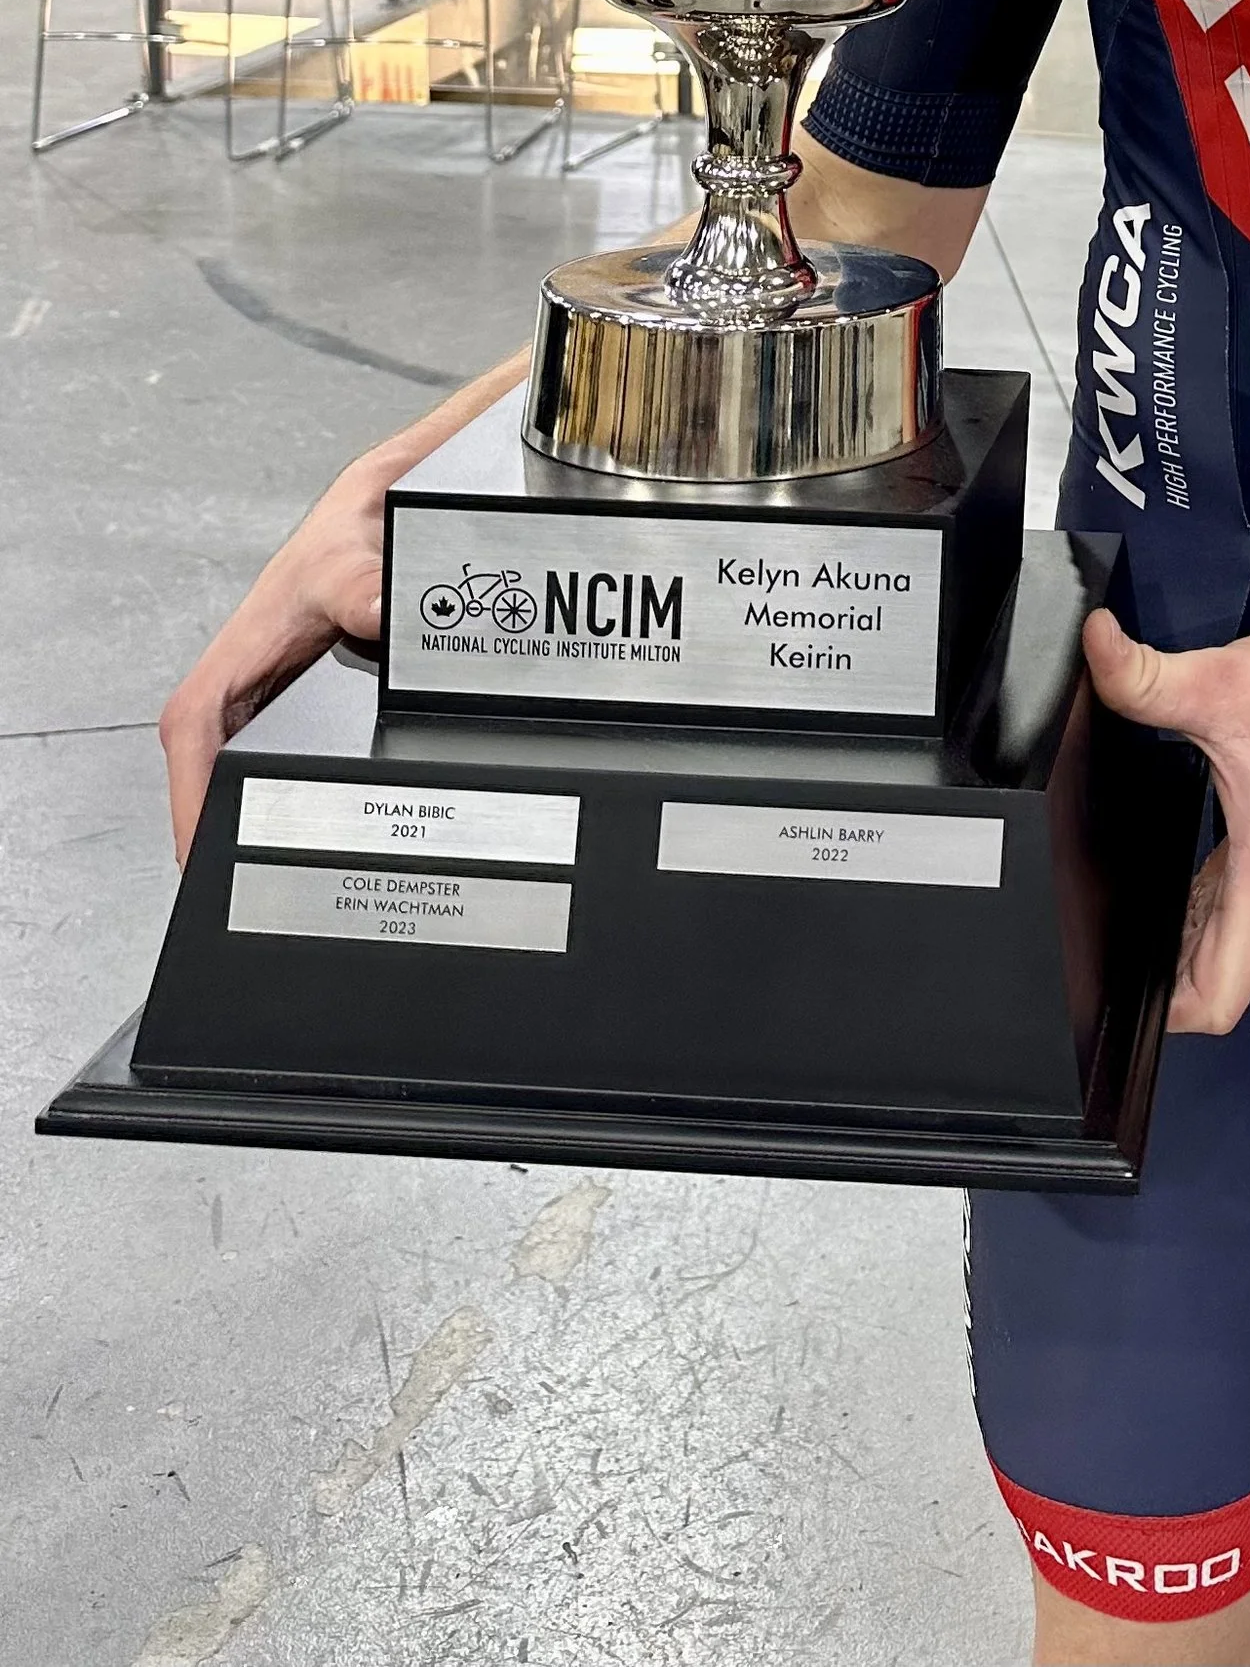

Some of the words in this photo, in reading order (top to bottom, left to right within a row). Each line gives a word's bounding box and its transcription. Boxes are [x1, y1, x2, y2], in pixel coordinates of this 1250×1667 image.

[1156, 223, 1183, 303] CYCLING
[1093, 203, 1152, 510] KWCA
[1151, 309, 1182, 460] PERFORMANCE
[1166, 458, 1191, 510] HIGH
[717, 557, 800, 593] Kelyn
[811, 562, 912, 593] Akuna
[543, 569, 684, 641] NCIM
[744, 602, 883, 632] Memorial
[421, 634, 488, 654] NATIONAL
[493, 637, 551, 658] CYCLING
[556, 640, 626, 661] INSTITUTE
[630, 643, 681, 663] MILTON
[769, 643, 852, 671] Keirin
[363, 801, 414, 818] DYLAN
[418, 804, 456, 820] BIBIC
[391, 824, 427, 839] 2021
[778, 825, 833, 840] ASHLIN
[838, 828, 884, 843] BARRY
[811, 847, 849, 862] 2022
[342, 876, 382, 893] COLE
[386, 879, 460, 897] DEMPSTER
[335, 896, 368, 912] ERIN
[373, 899, 464, 917] WACHTMAN
[379, 920, 416, 935] 2023
[1017, 1517, 1241, 1595] AKROO
